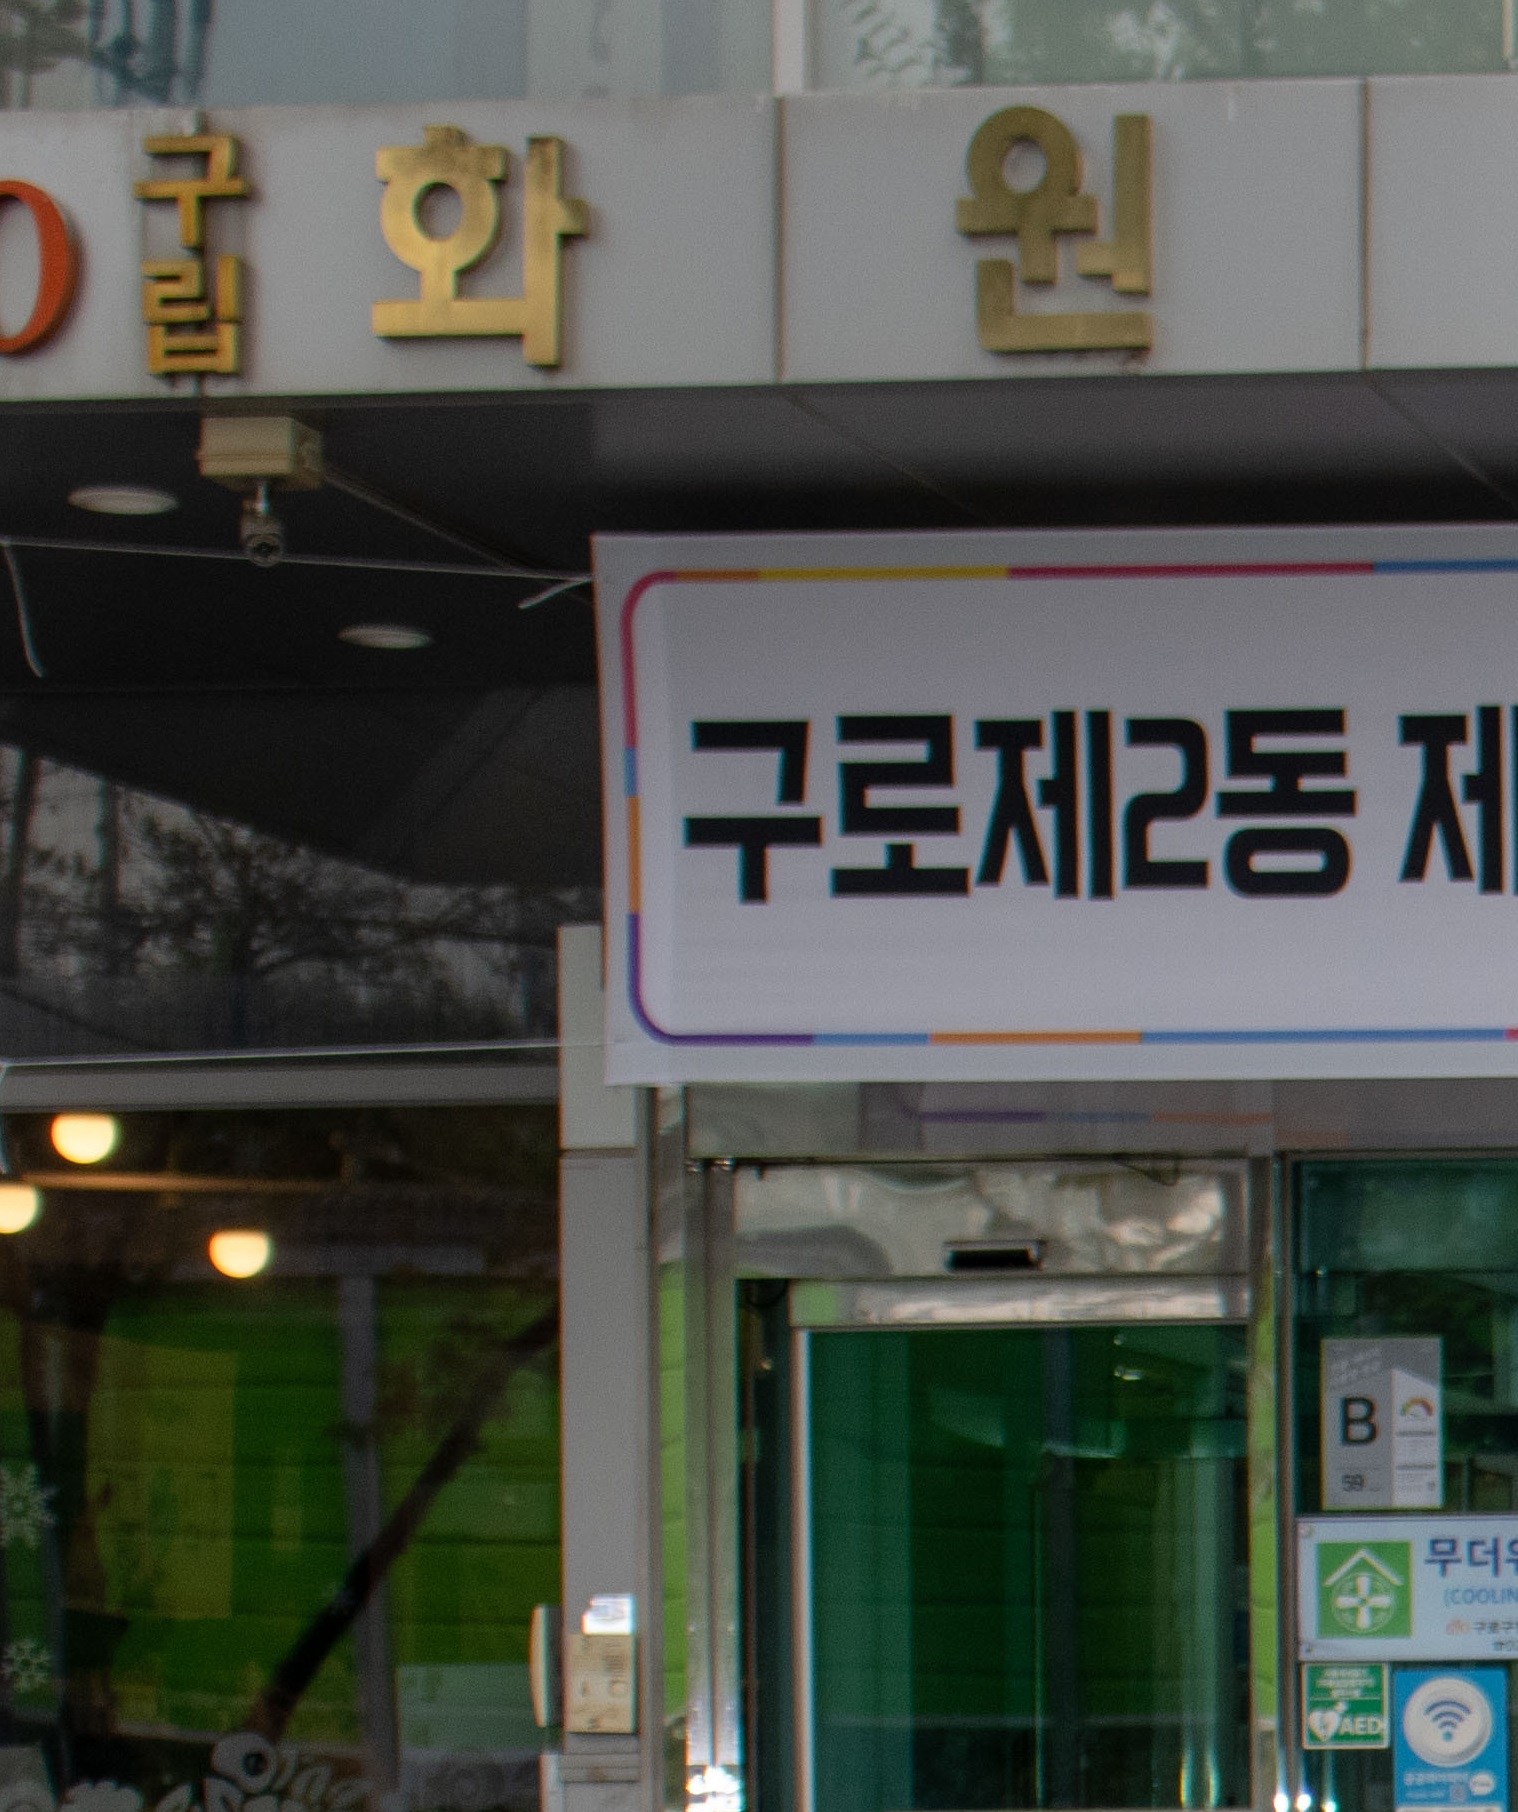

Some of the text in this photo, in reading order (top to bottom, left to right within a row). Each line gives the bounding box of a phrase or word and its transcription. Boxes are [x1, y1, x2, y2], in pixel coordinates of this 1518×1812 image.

[134, 134, 248, 378] 구립
[683, 708, 1357, 905] 구로제2동
[1341, 1396, 1378, 1446] B
[1339, 1715, 1382, 1736] AED
